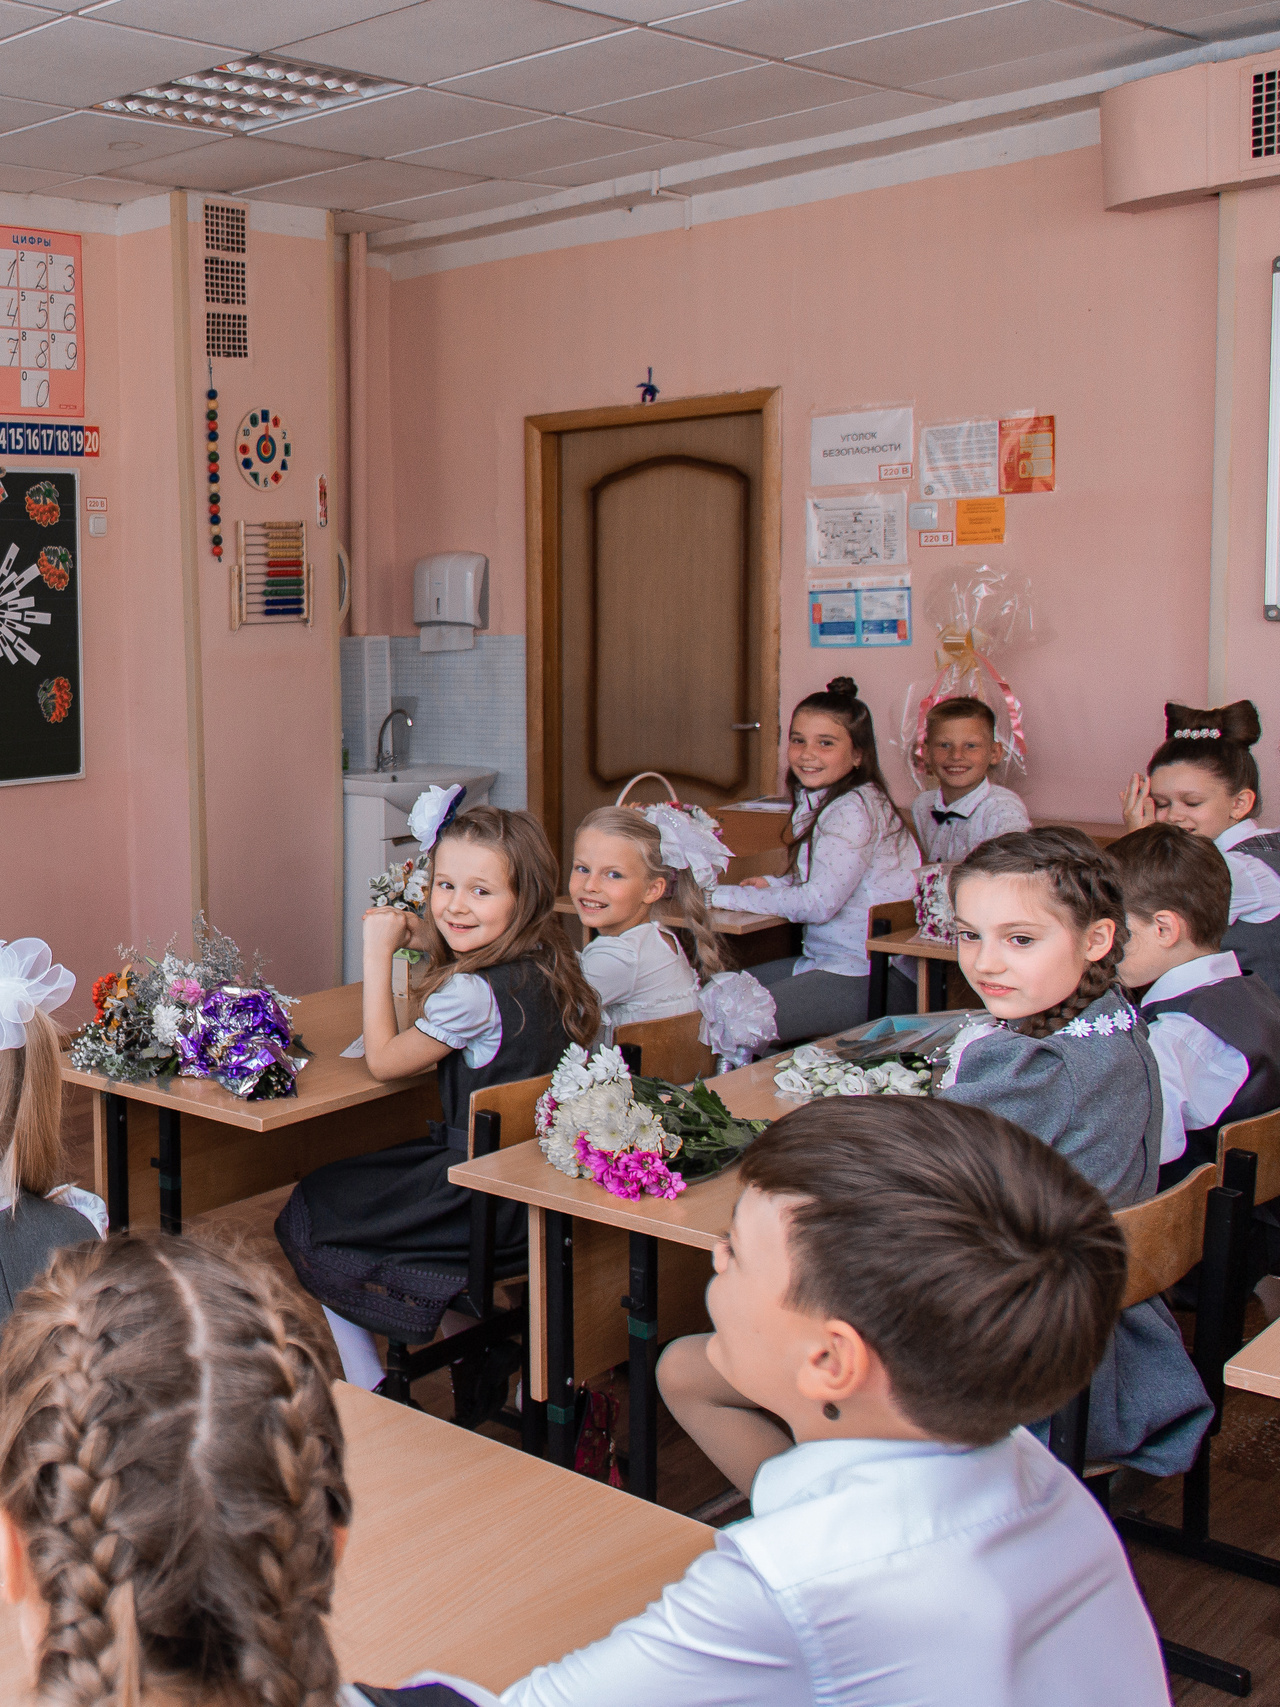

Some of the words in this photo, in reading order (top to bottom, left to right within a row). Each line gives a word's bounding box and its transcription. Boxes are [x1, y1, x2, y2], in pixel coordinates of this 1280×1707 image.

[12, 235, 51, 247] ЦИФРЫ
[20, 252, 25, 261] 2
[49, 255, 53, 265] 3
[8, 259, 17, 286] 1
[36, 261, 47, 290] 2
[63, 264, 75, 292] 3
[21, 292, 26, 301] 5
[50, 295, 54, 304] 6
[7, 298, 18, 326] 4
[36, 301, 48, 329] 5
[63, 304, 76, 331] 6
[22, 332, 26, 341] 8
[51, 334, 55, 343] 9
[8, 338, 19, 366] 7
[36, 340, 48, 368] 8
[65, 342, 77, 370] 9
[22, 371, 27, 381] 0
[36, 380, 49, 407] 0
[9, 428, 24, 450] 15
[27, 428, 39, 451] 16
[42, 429, 54, 451] 17
[57, 429, 69, 451] 18
[71, 430, 83, 452] 19
[85, 430, 98, 452] 20
[841, 432, 877, 442] УГОЛОК
[823, 443, 901, 458] БЕЗОПАСНОСТИ
[883, 468, 899, 476] 220
